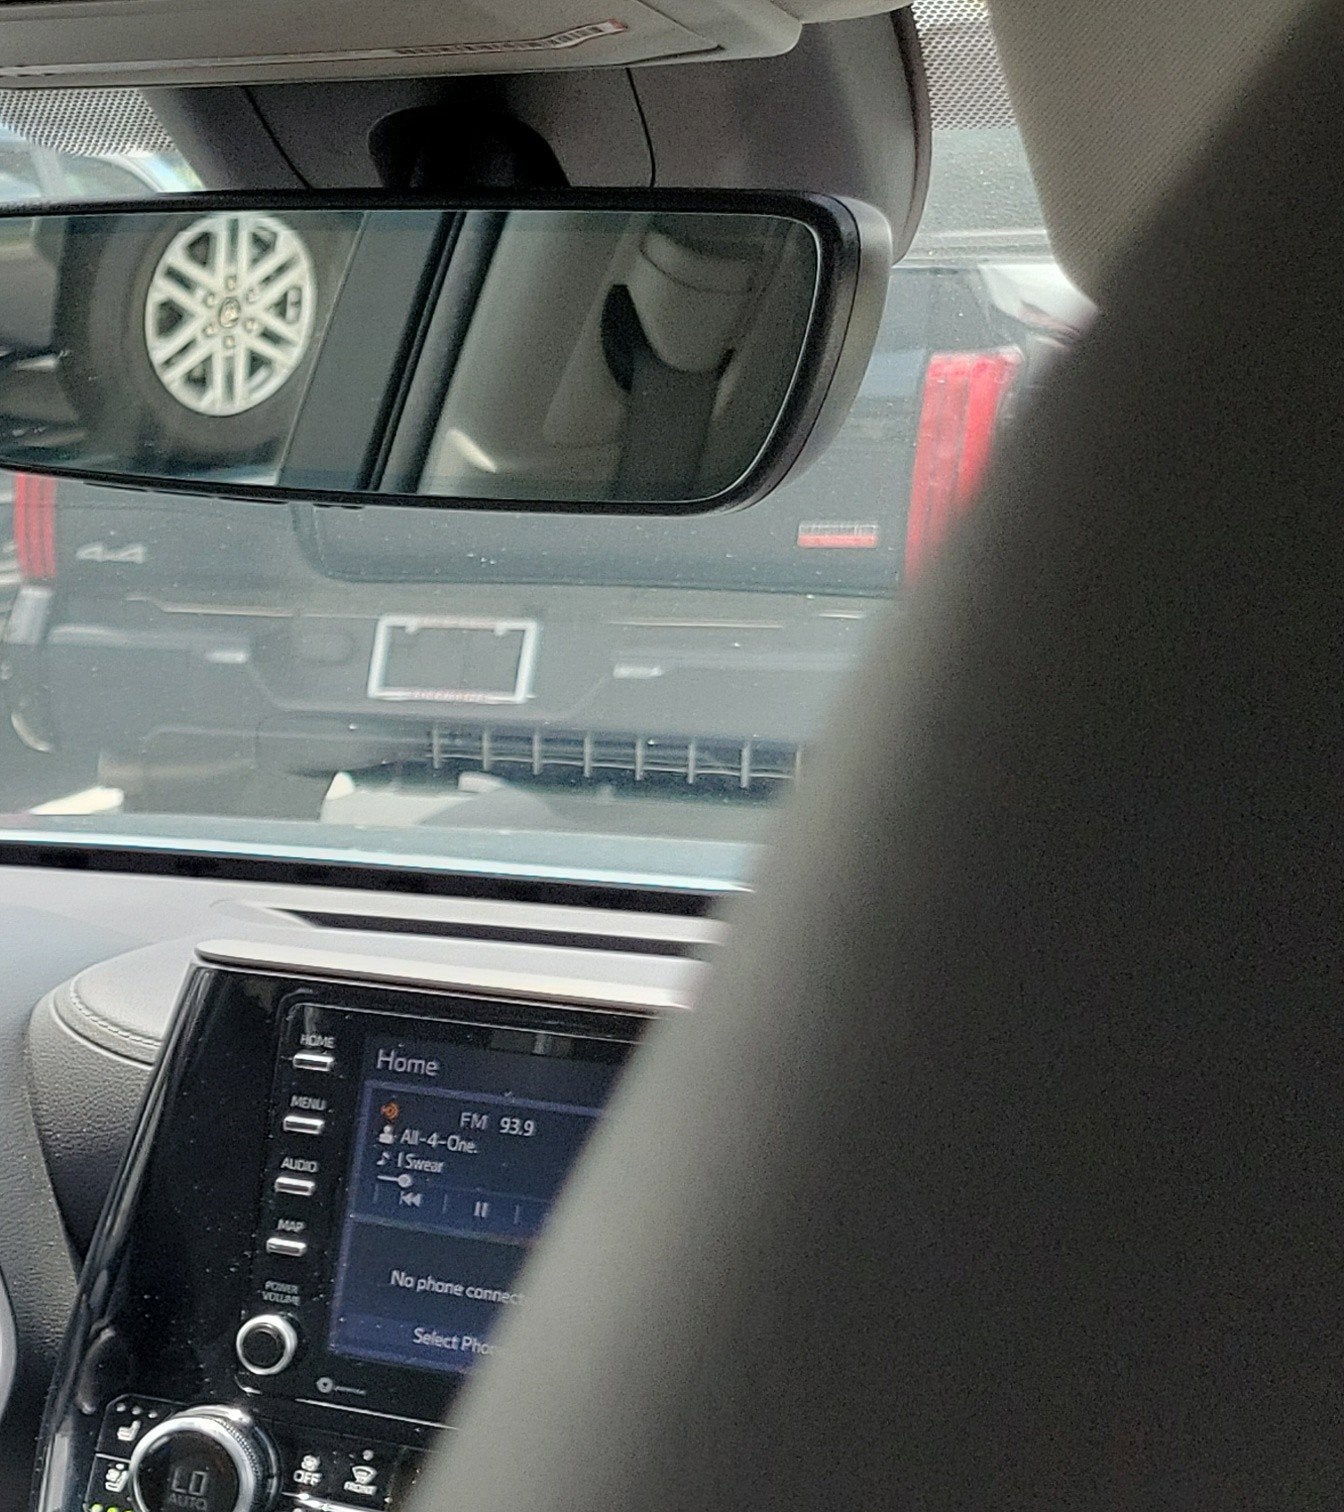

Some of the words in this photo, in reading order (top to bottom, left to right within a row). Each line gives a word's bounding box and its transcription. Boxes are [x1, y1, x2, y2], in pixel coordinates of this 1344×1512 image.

[299, 1033, 336, 1049] HOME
[375, 1048, 439, 1077] Home
[289, 1094, 327, 1111] MENU
[459, 1112, 489, 1131] FM
[499, 1116, 535, 1137] 93.9
[280, 1156, 319, 1173] AUDIO
[404, 1153, 445, 1174] Swear
[276, 1217, 305, 1233] MAP
[264, 1280, 299, 1295] POWER
[390, 1269, 414, 1289] No
[415, 1275, 464, 1298] phone
[261, 1290, 301, 1306] VOLUME
[412, 1327, 461, 1351] Select
[170, 1466, 209, 1496] LO
[292, 1468, 323, 1487] OFF
[343, 1480, 378, 1496] FRONT
[168, 1492, 209, 1512] AUTO
